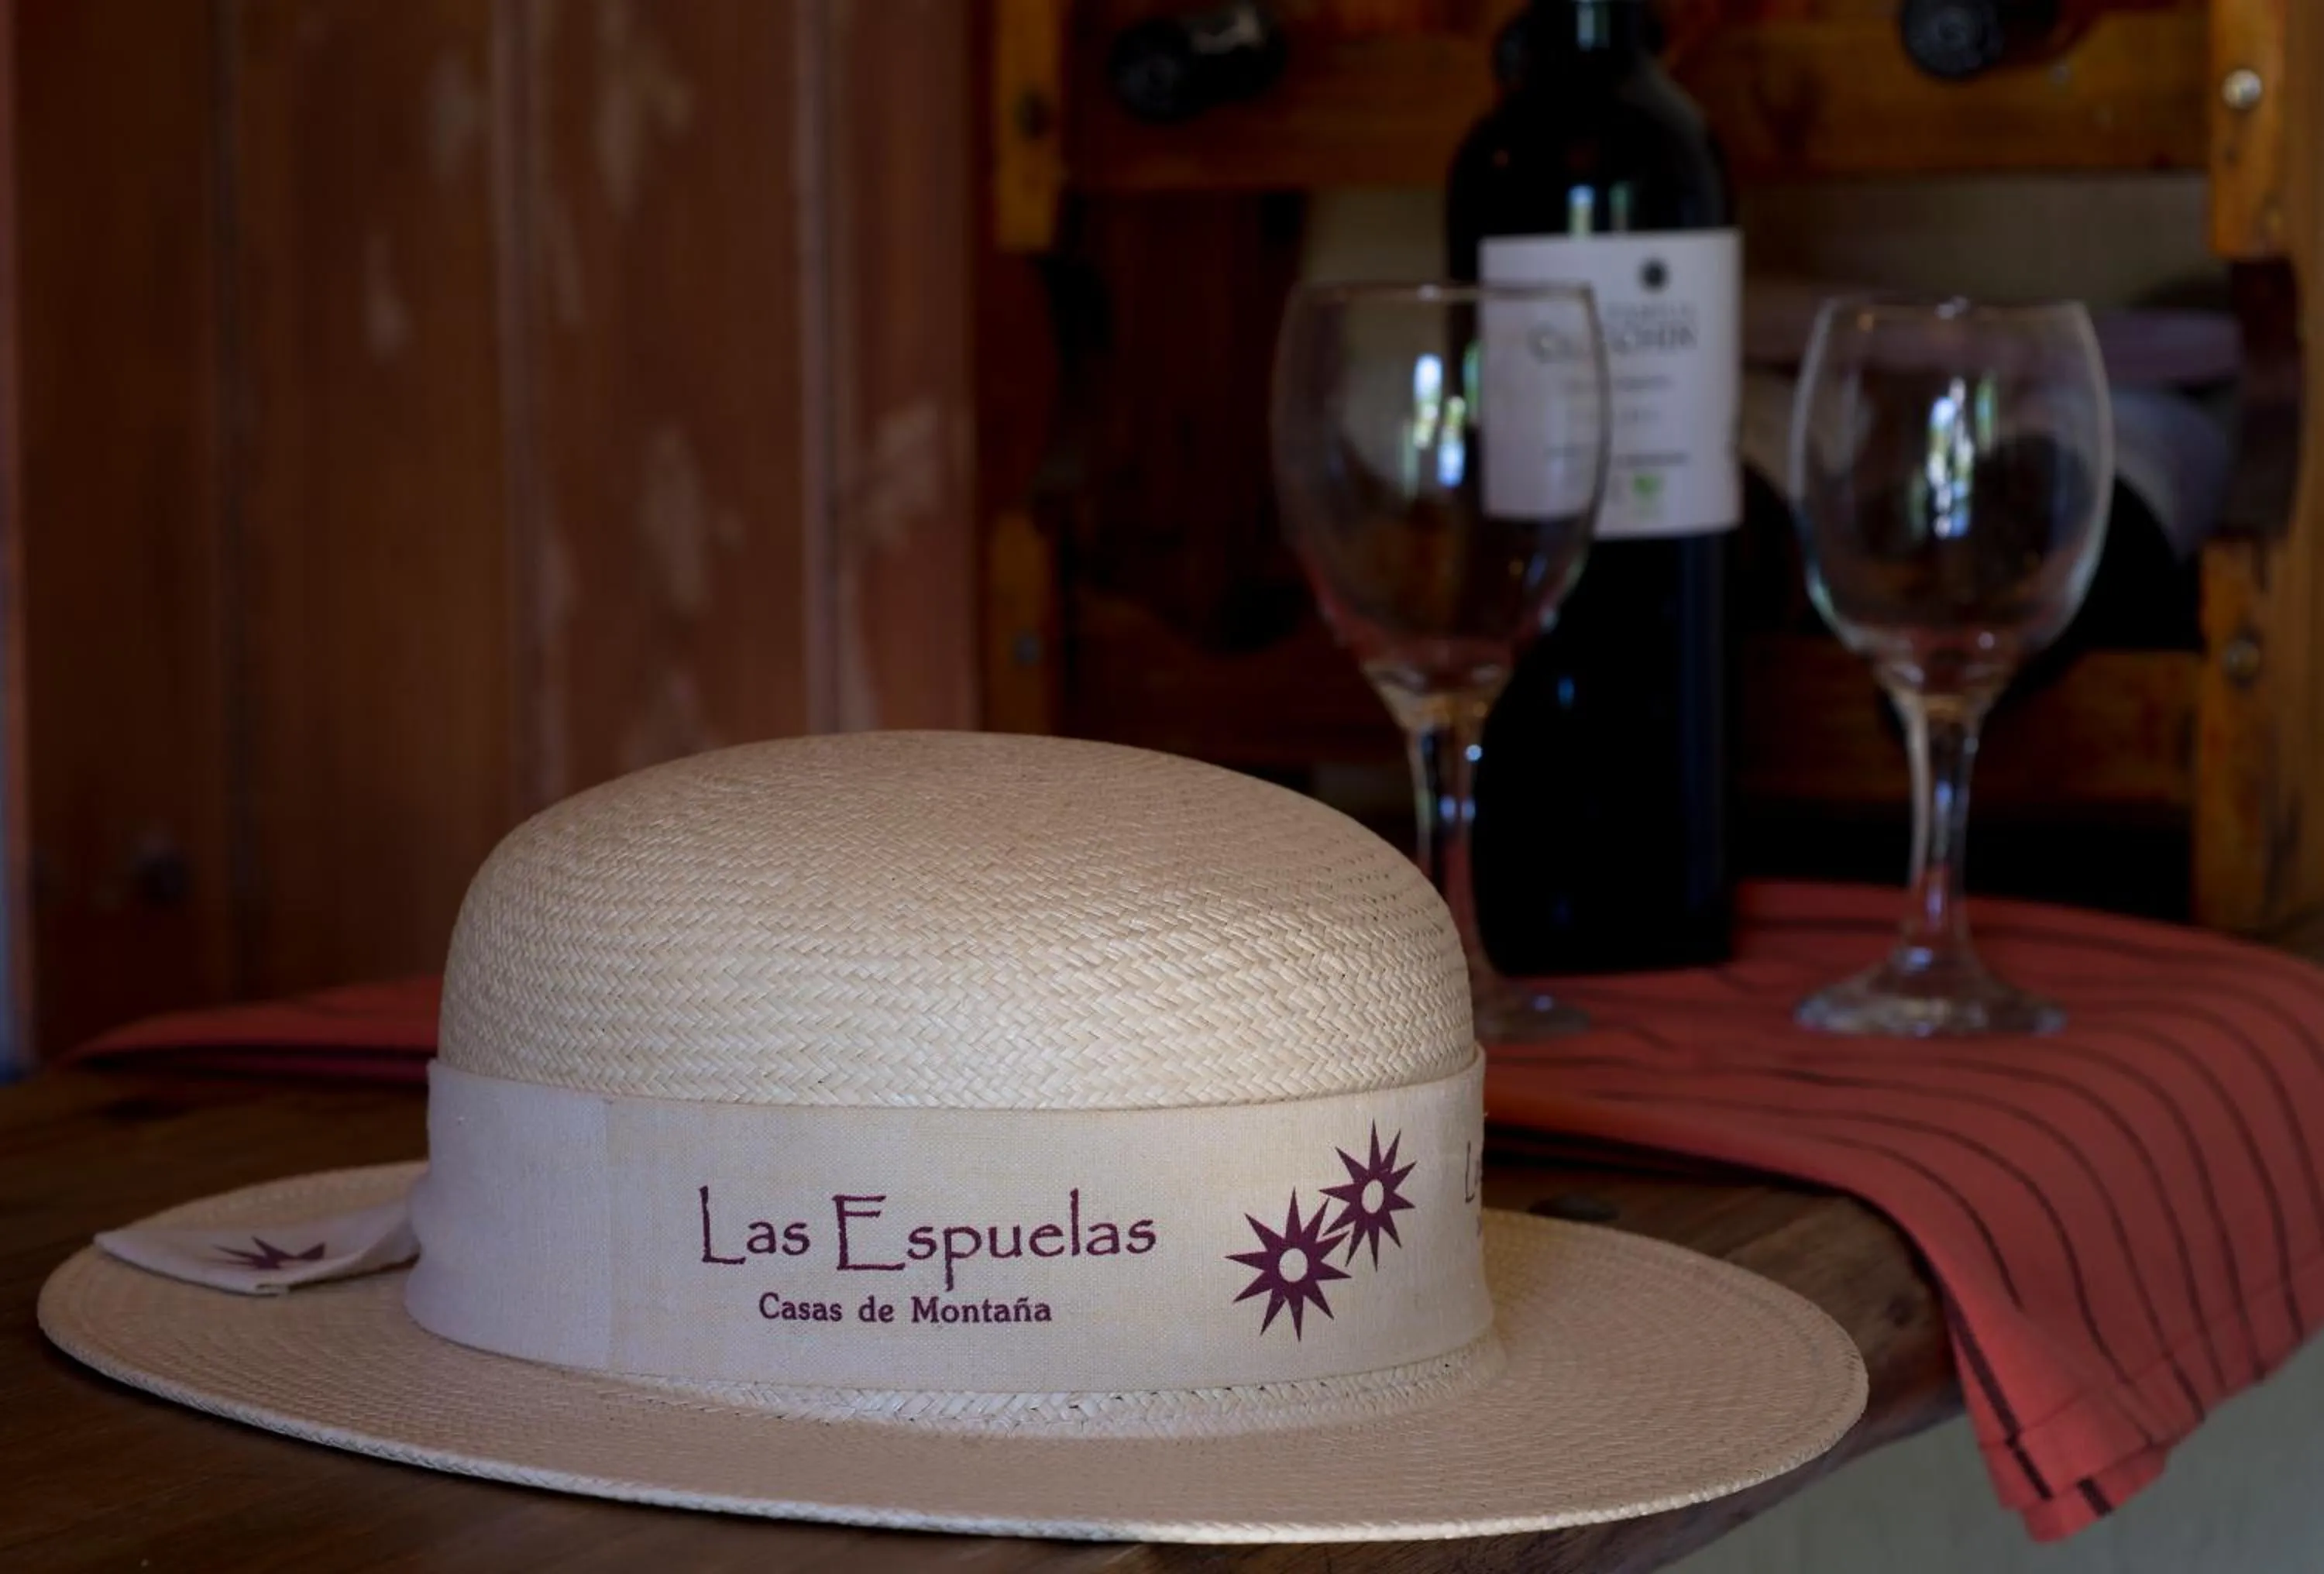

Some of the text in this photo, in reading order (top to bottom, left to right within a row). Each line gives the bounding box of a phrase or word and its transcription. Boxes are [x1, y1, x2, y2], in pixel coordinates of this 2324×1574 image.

[699, 1185, 1157, 1292] Las Espuelas
[758, 1291, 1052, 1324] Casas de Montaña
